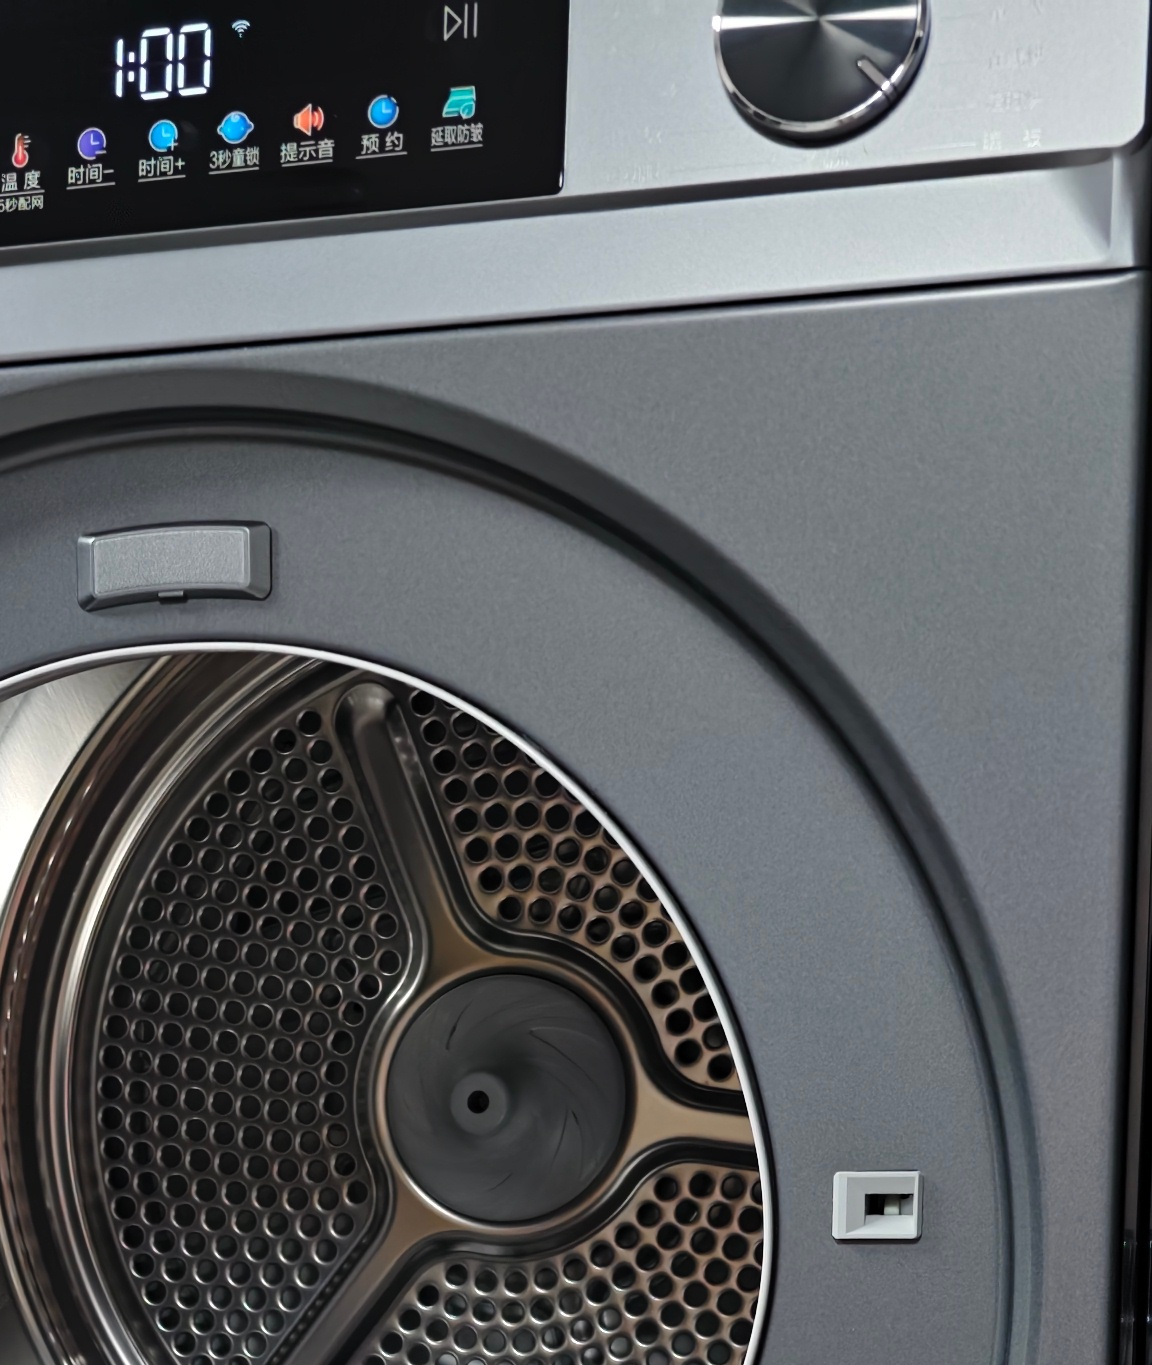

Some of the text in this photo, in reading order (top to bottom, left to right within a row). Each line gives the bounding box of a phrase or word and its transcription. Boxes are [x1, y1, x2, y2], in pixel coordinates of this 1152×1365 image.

[114, 22, 213, 100] 1:00
[361, 131, 404, 155] 预约
[431, 123, 484, 147] 延取防皱
[209, 148, 260, 169] 3秒童锁
[280, 139, 335, 163] 提示音
[138, 156, 185, 177] 时间+
[1, 170, 41, 192] 温度
